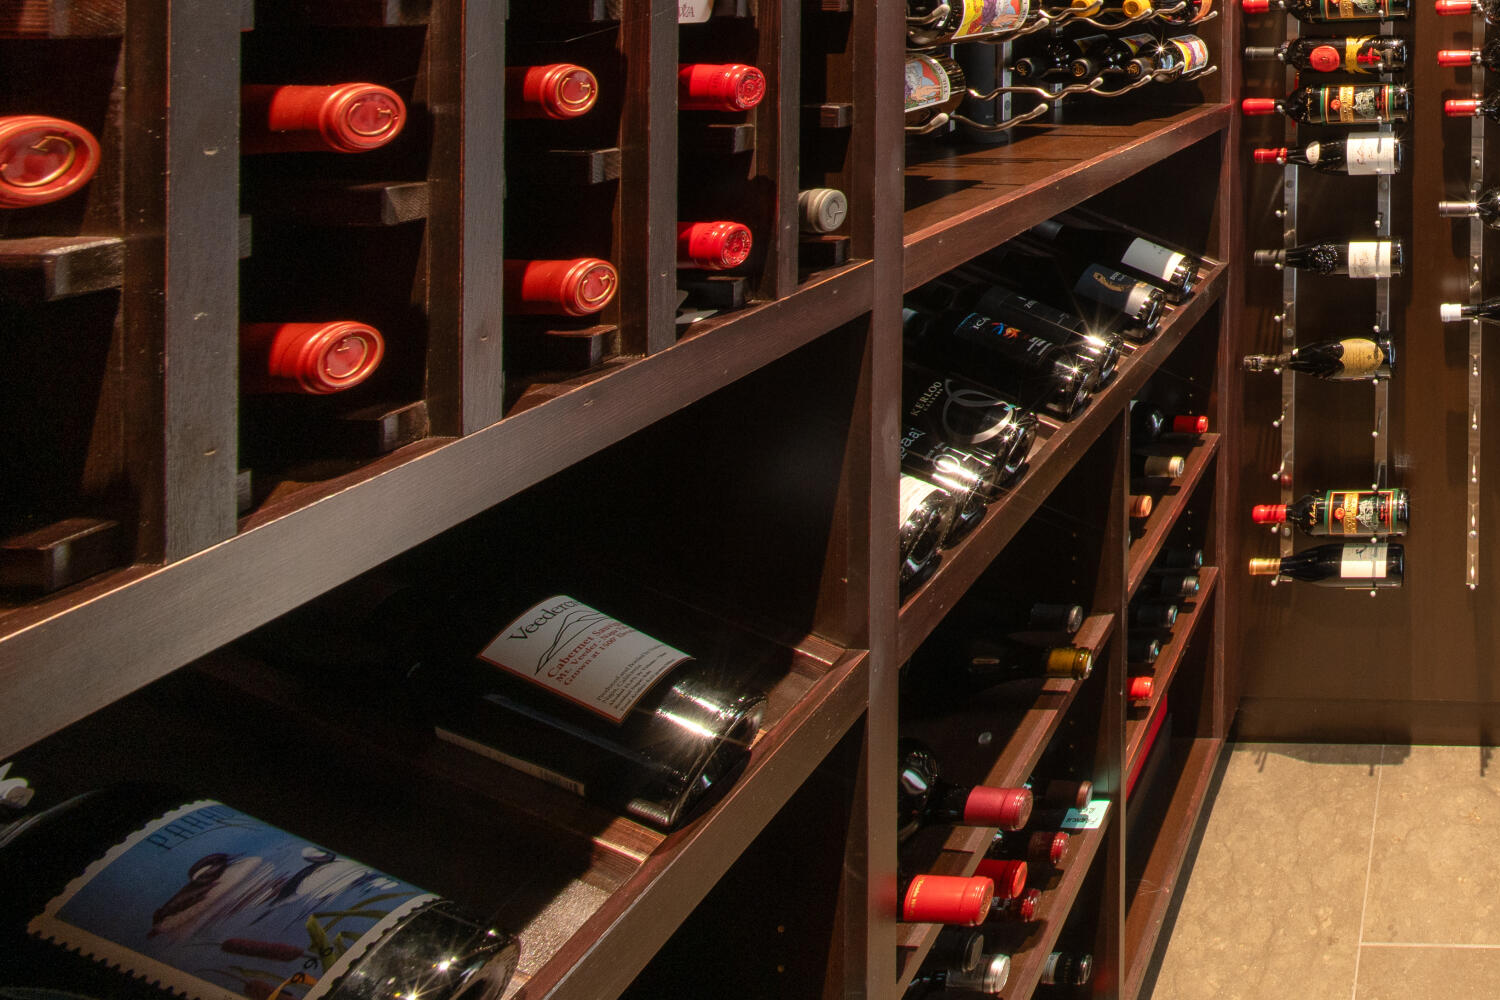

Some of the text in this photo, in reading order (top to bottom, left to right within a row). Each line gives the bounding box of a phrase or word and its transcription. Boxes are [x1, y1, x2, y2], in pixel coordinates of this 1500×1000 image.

[910, 381, 943, 416] KERLOO
[547, 636, 594, 678] Cabernet
[563, 656, 592, 687] Grown
